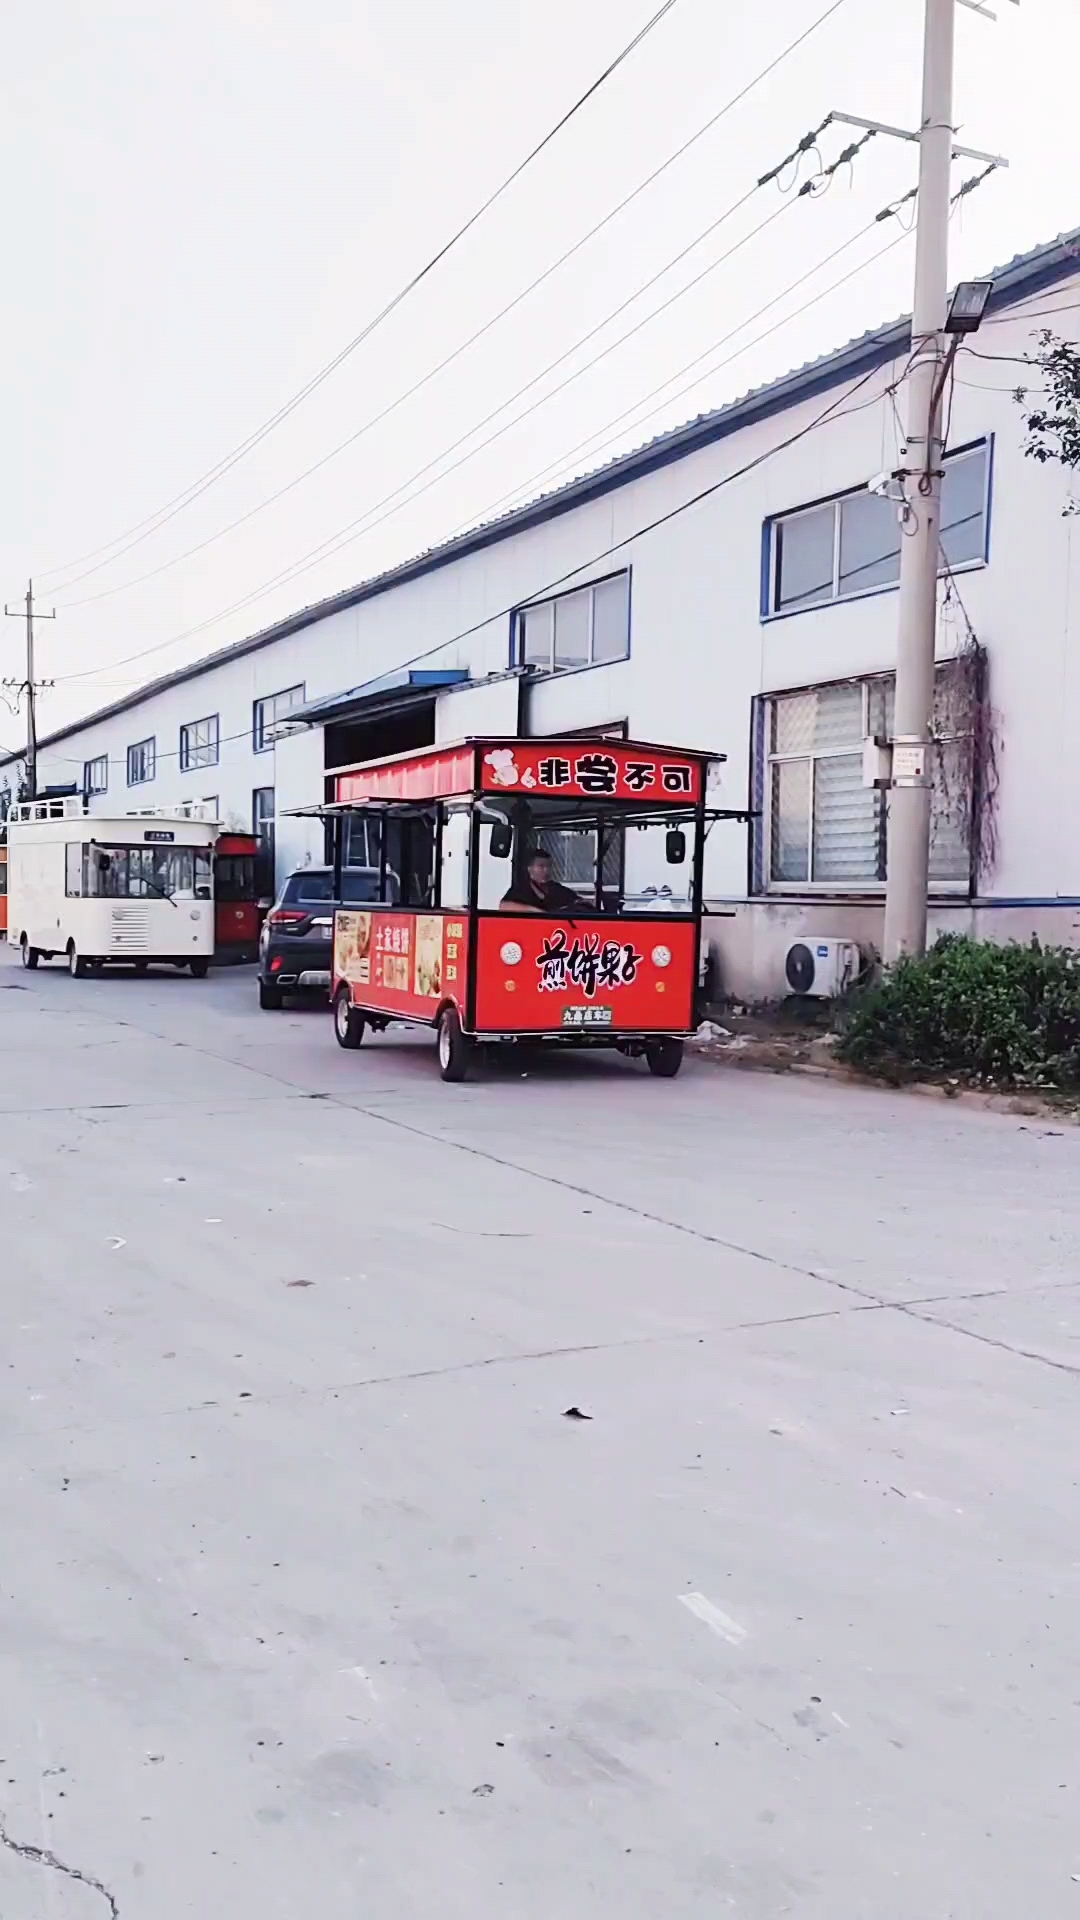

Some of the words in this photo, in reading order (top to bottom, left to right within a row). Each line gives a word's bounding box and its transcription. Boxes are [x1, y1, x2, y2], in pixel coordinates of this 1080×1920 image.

[538, 754, 692, 794] 非尝不可
[536, 928, 643, 998] 煎饼果子
